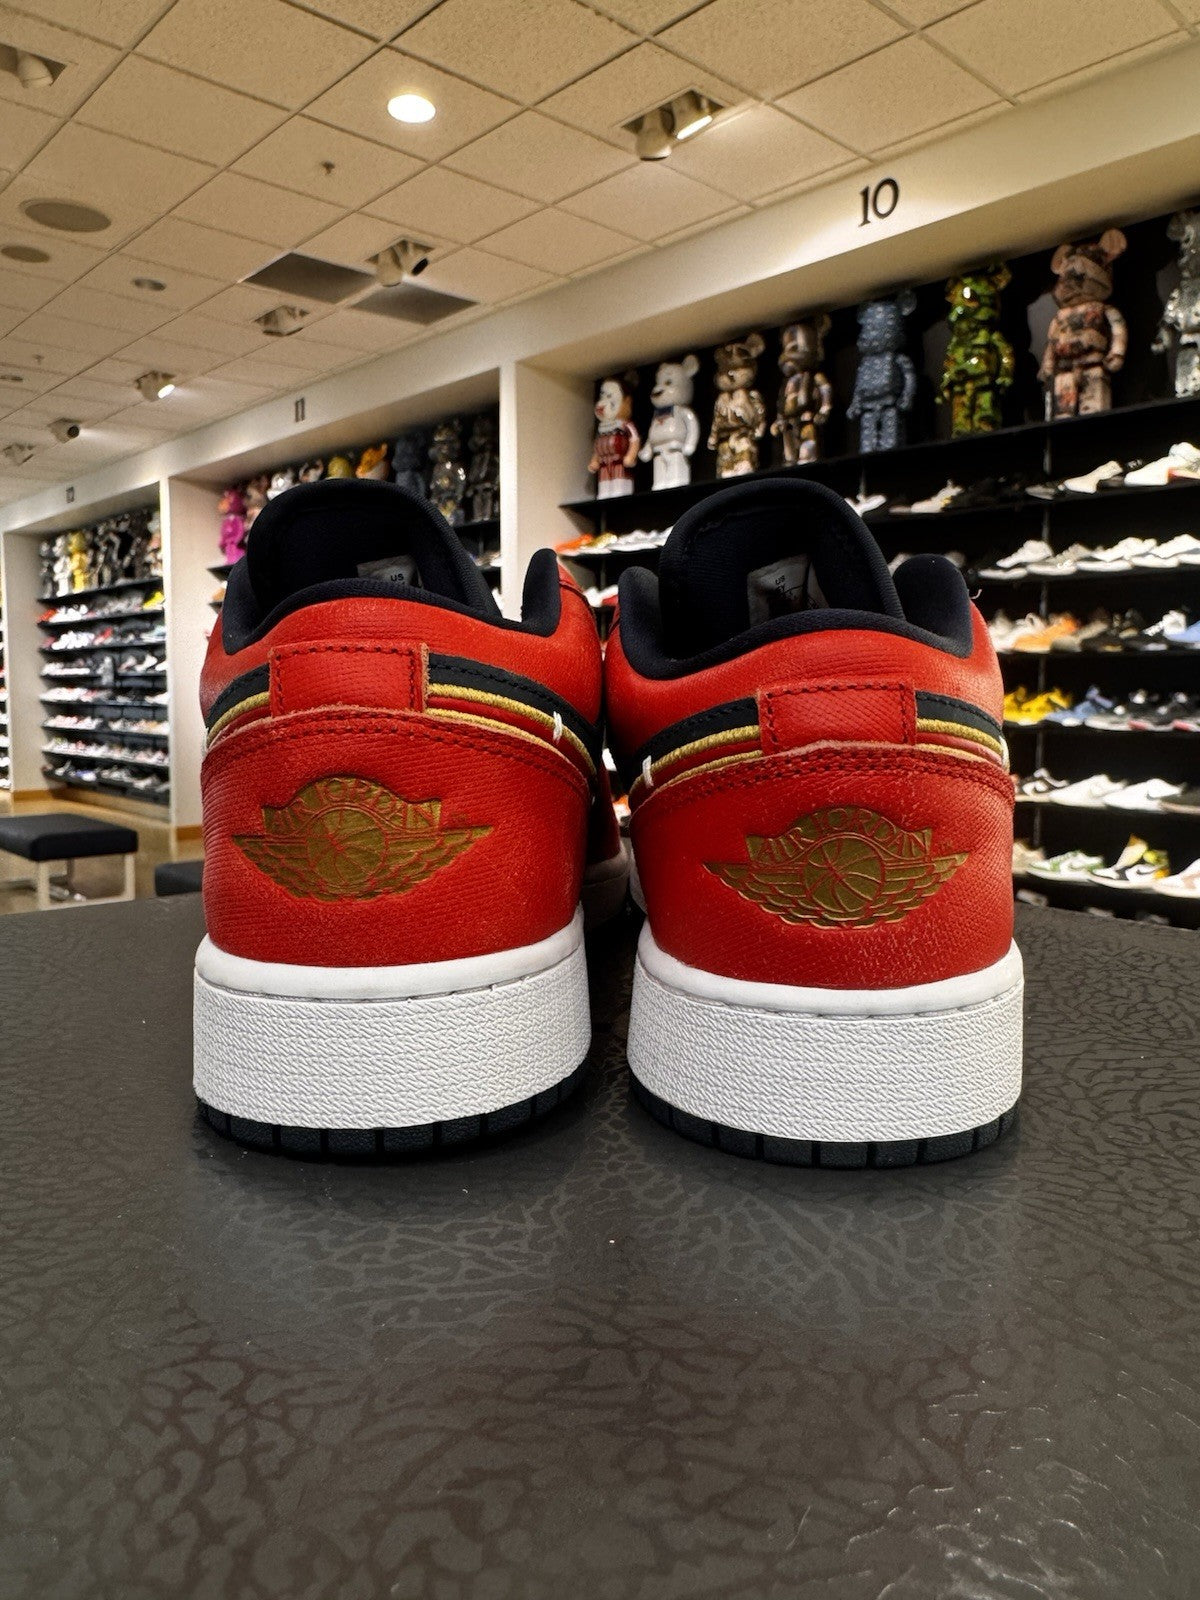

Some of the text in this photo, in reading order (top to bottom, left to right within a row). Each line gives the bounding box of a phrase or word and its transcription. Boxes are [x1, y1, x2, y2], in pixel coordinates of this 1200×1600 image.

[858, 178, 900, 227] 10
[390, 573, 404, 582] US
[775, 575, 785, 584] US
[268, 777, 440, 832] AIR JORDAN
[756, 807, 931, 865] AIR JORDAN
